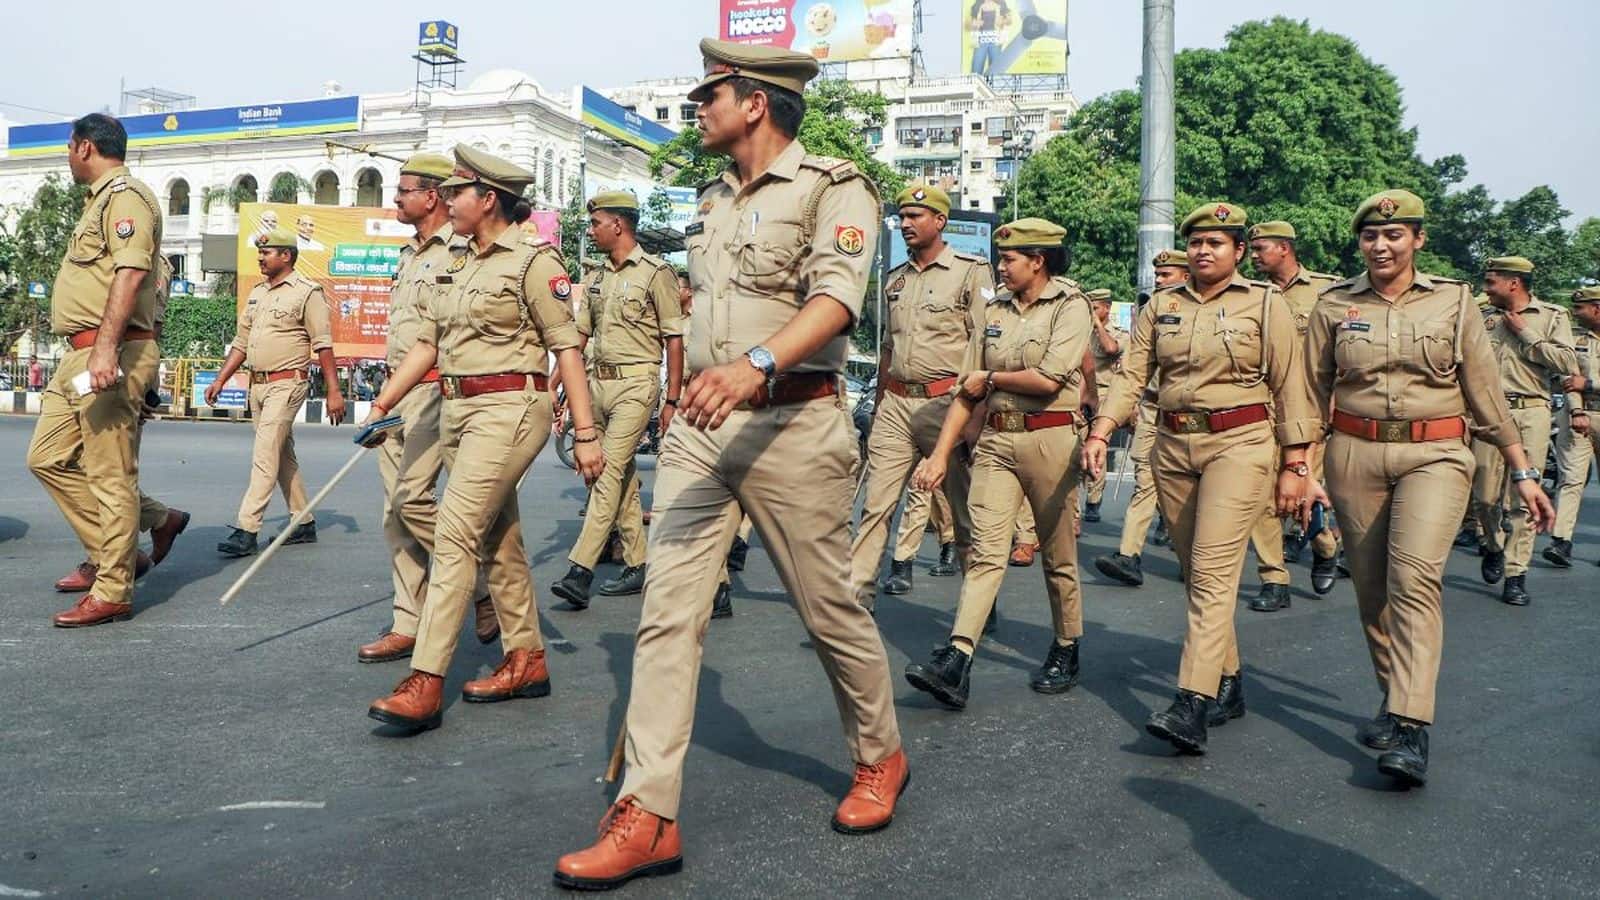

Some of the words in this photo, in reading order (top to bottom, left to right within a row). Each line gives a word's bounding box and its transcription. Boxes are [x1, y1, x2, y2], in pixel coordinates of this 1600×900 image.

[730, 7, 770, 20] hooked
[772, 7, 786, 16] on
[728, 16, 787, 37] HOCCO
[238, 108, 263, 119] Indian
[263, 106, 282, 118] Bank
